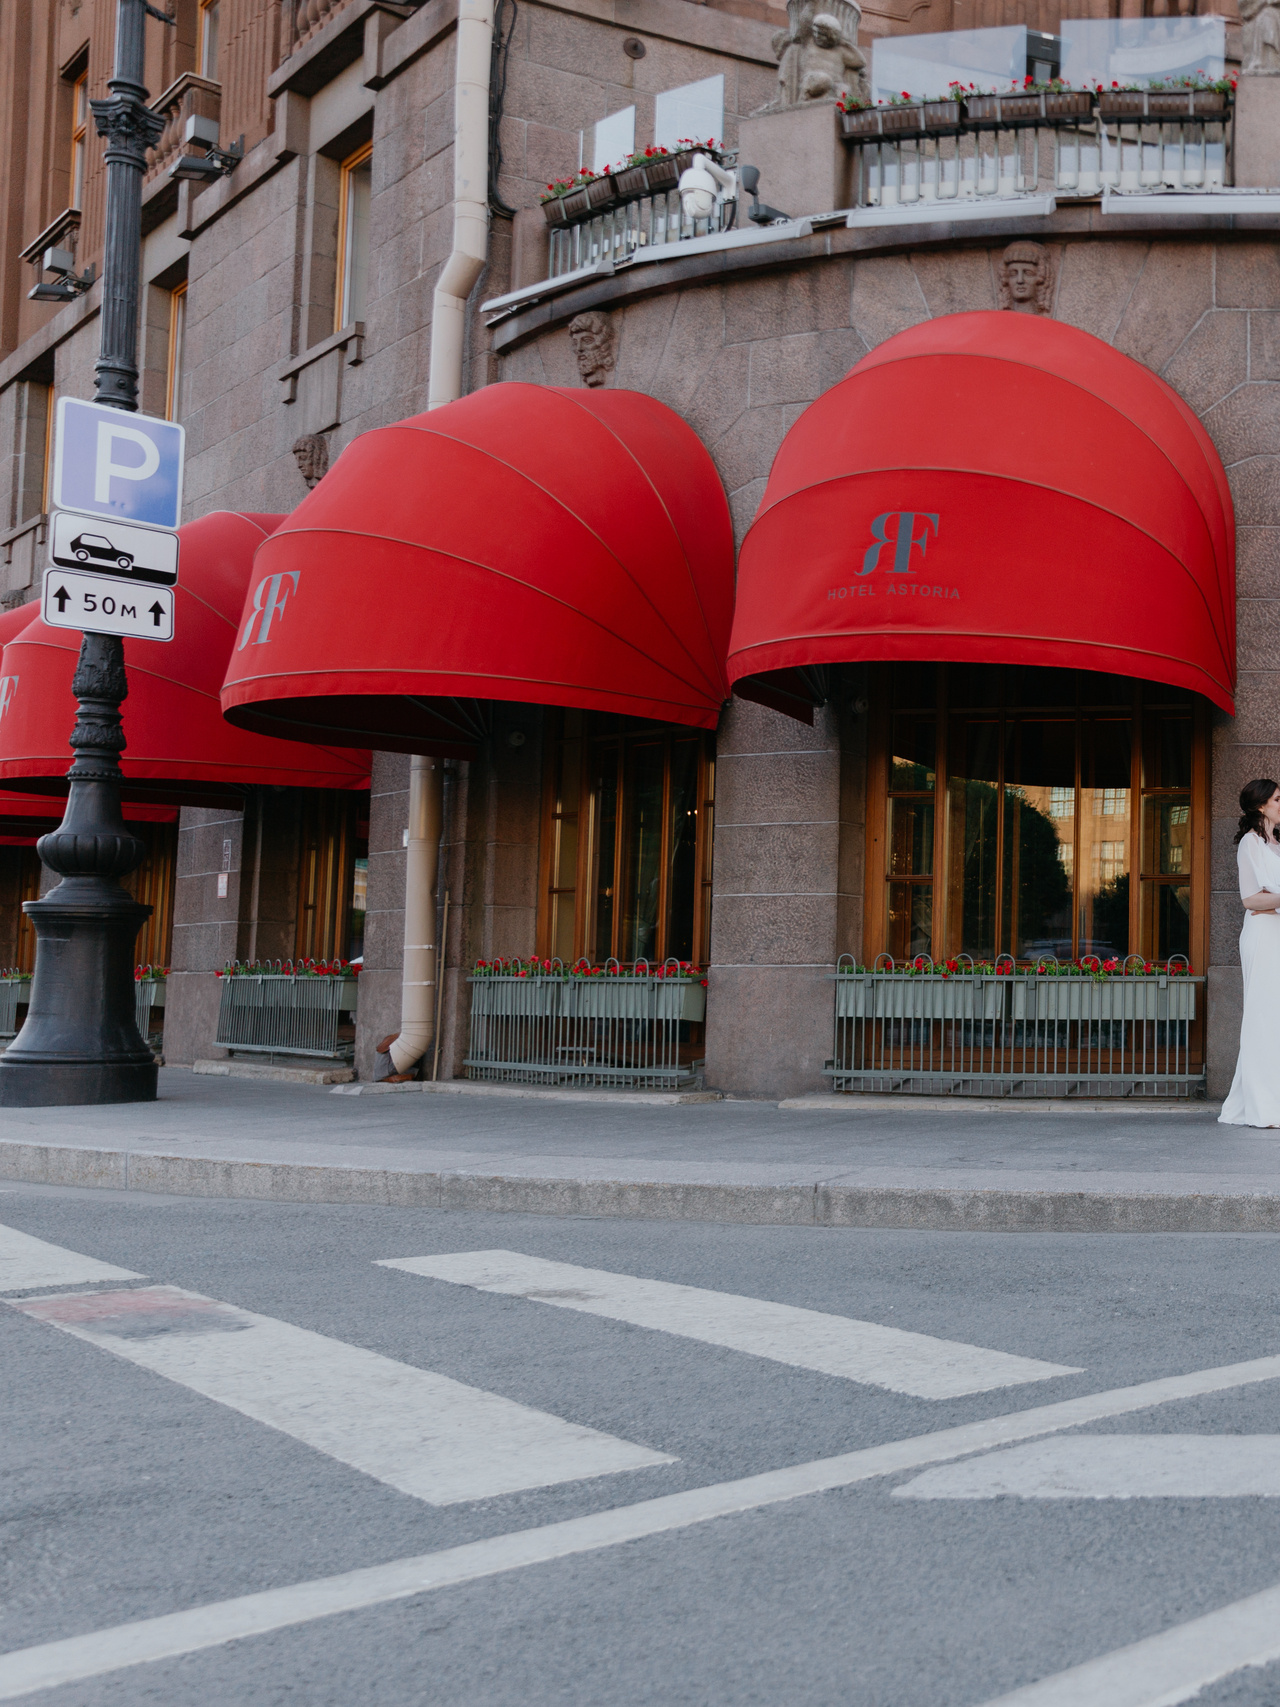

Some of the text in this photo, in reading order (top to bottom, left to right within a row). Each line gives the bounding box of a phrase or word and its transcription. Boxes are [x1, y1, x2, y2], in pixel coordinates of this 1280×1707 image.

[95, 421, 160, 504] P
[827, 583, 960, 600] HOTEL ASTORIA
